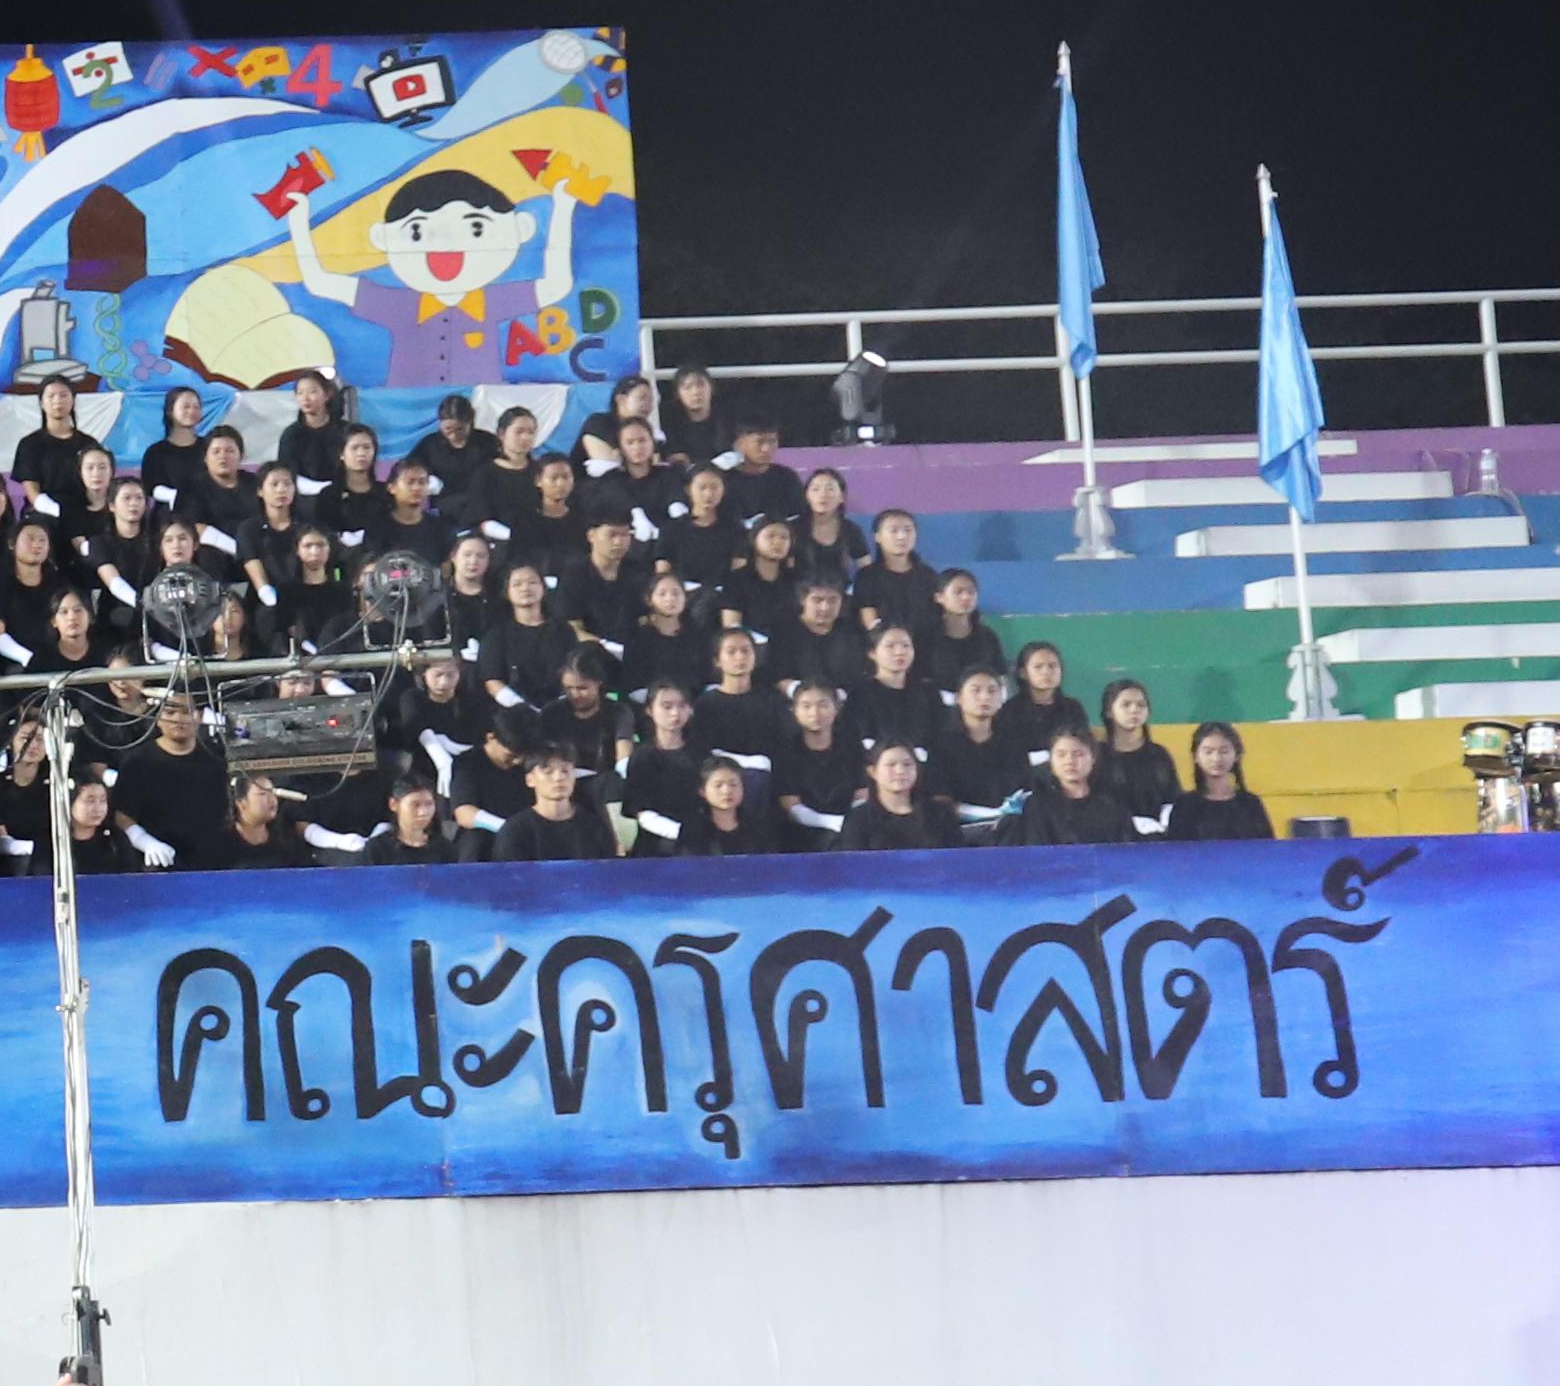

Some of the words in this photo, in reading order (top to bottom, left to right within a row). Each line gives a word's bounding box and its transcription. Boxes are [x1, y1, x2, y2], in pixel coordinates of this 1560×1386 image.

[287, 44, 342, 107] 4
[156, 847, 1419, 1160] คณะครุศาสตร์
